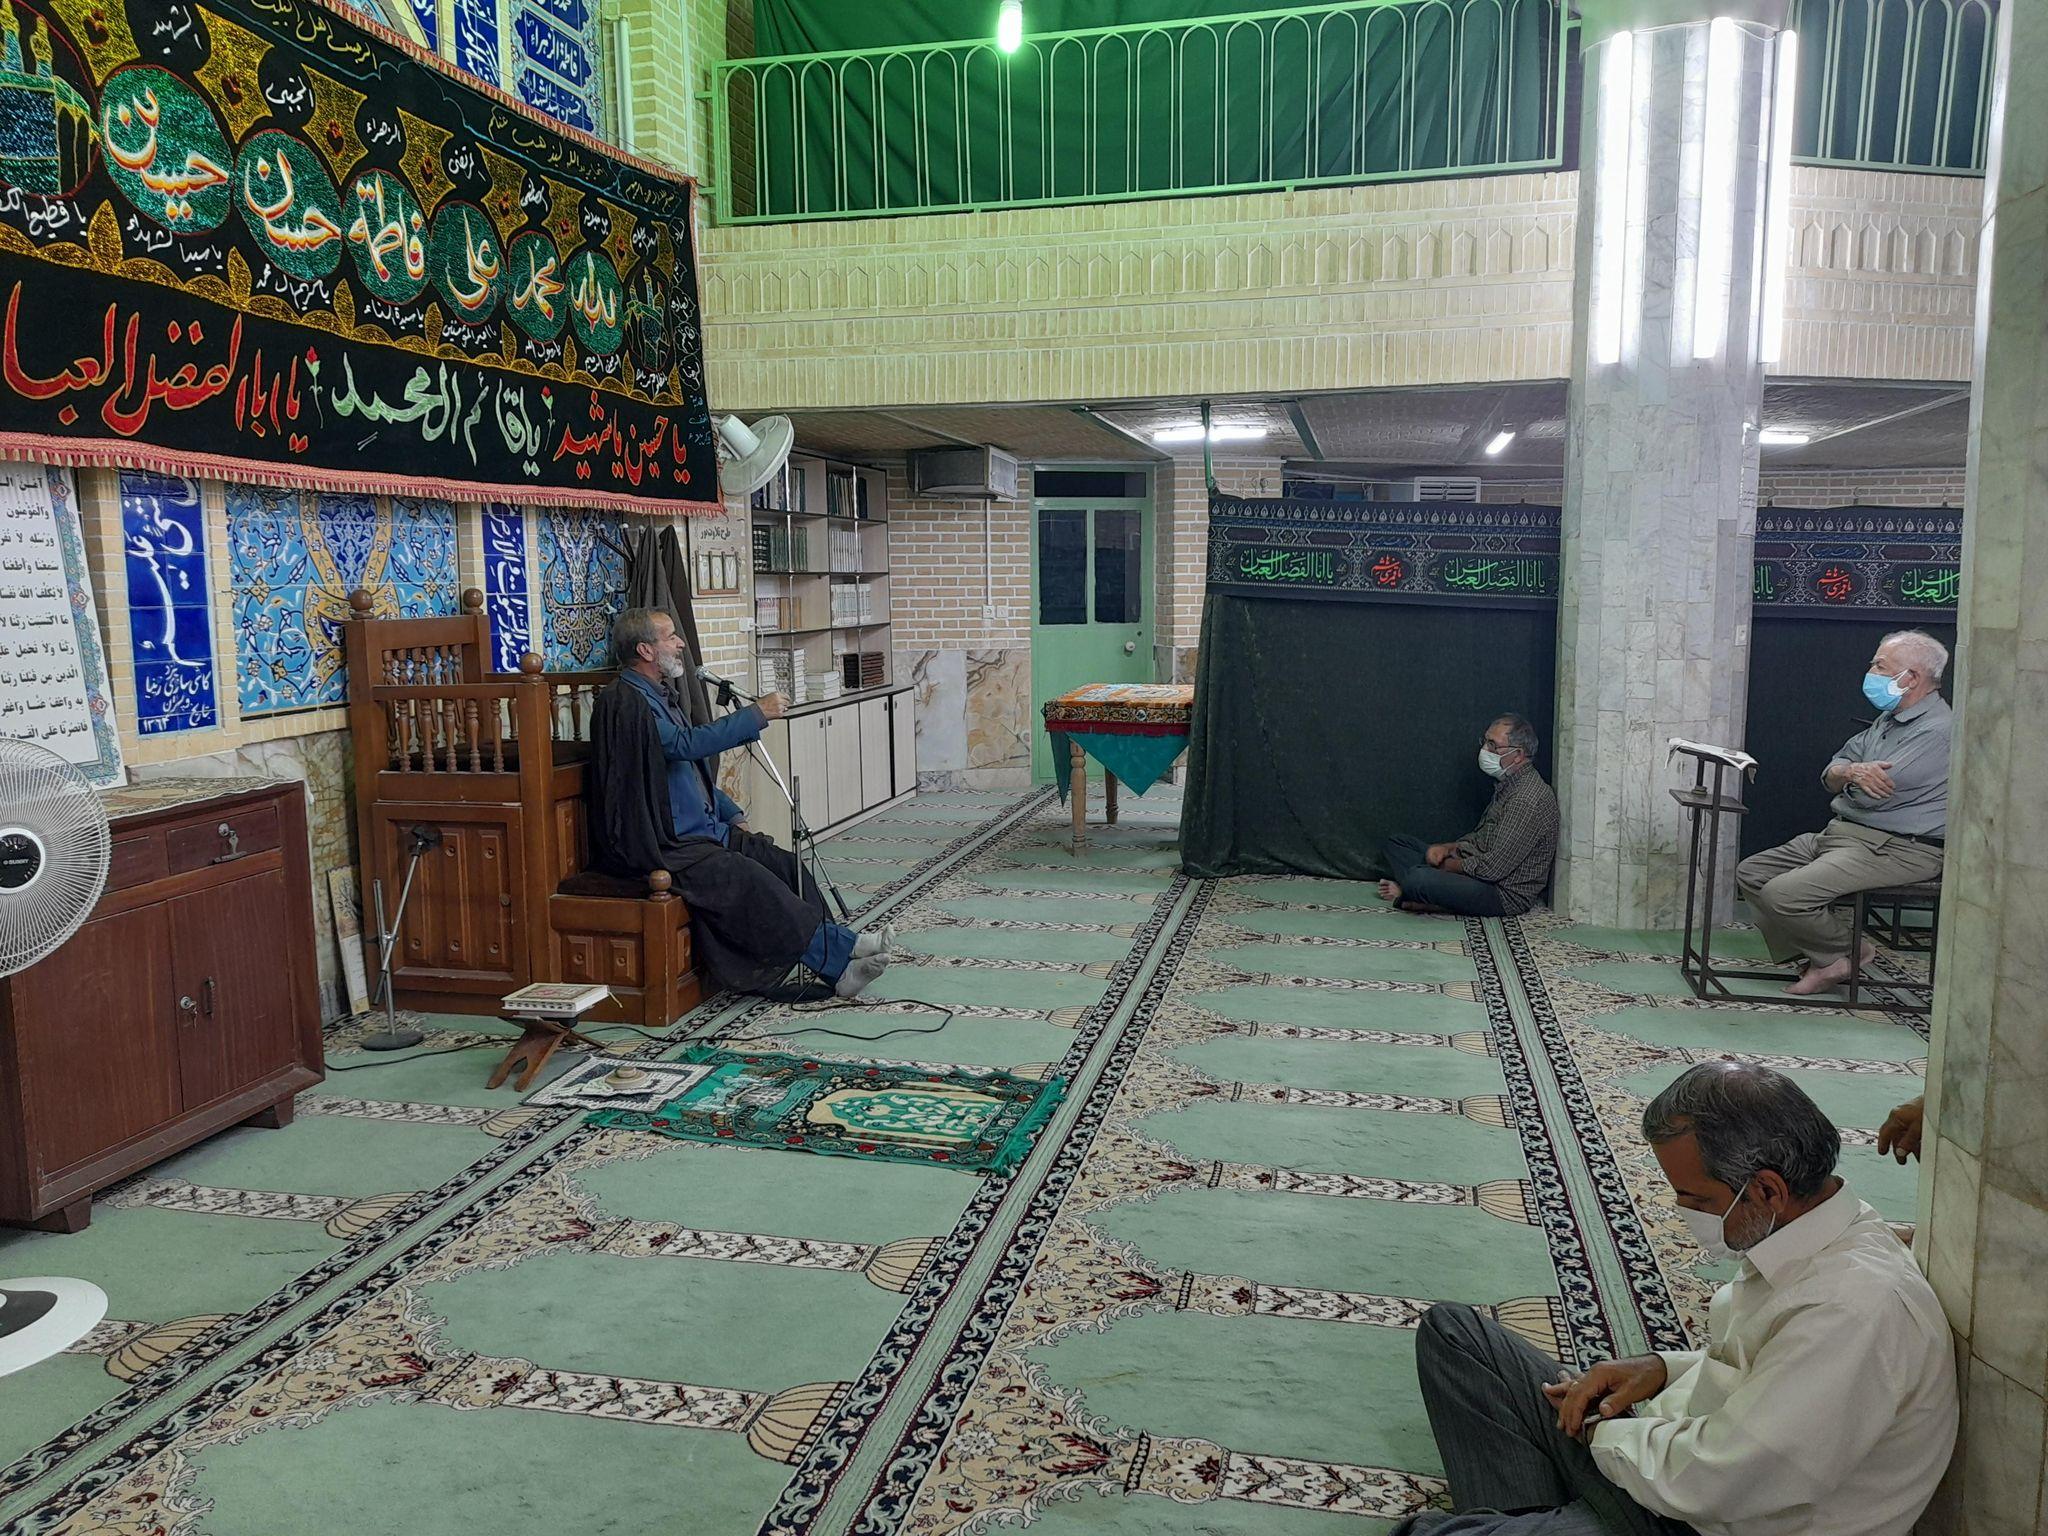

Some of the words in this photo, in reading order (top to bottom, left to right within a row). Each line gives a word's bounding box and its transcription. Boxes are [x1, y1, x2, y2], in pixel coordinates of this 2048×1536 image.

[105, 87, 229, 220] حسین
[73, 201, 88, 237] یا
[245, 148, 341, 250] حسن
[512, 240, 564, 320] محمد
[570, 251, 616, 333] الله
[286, 354, 309, 453] یا
[625, 413, 670, 487] حسین
[672, 423, 691, 484] یا
